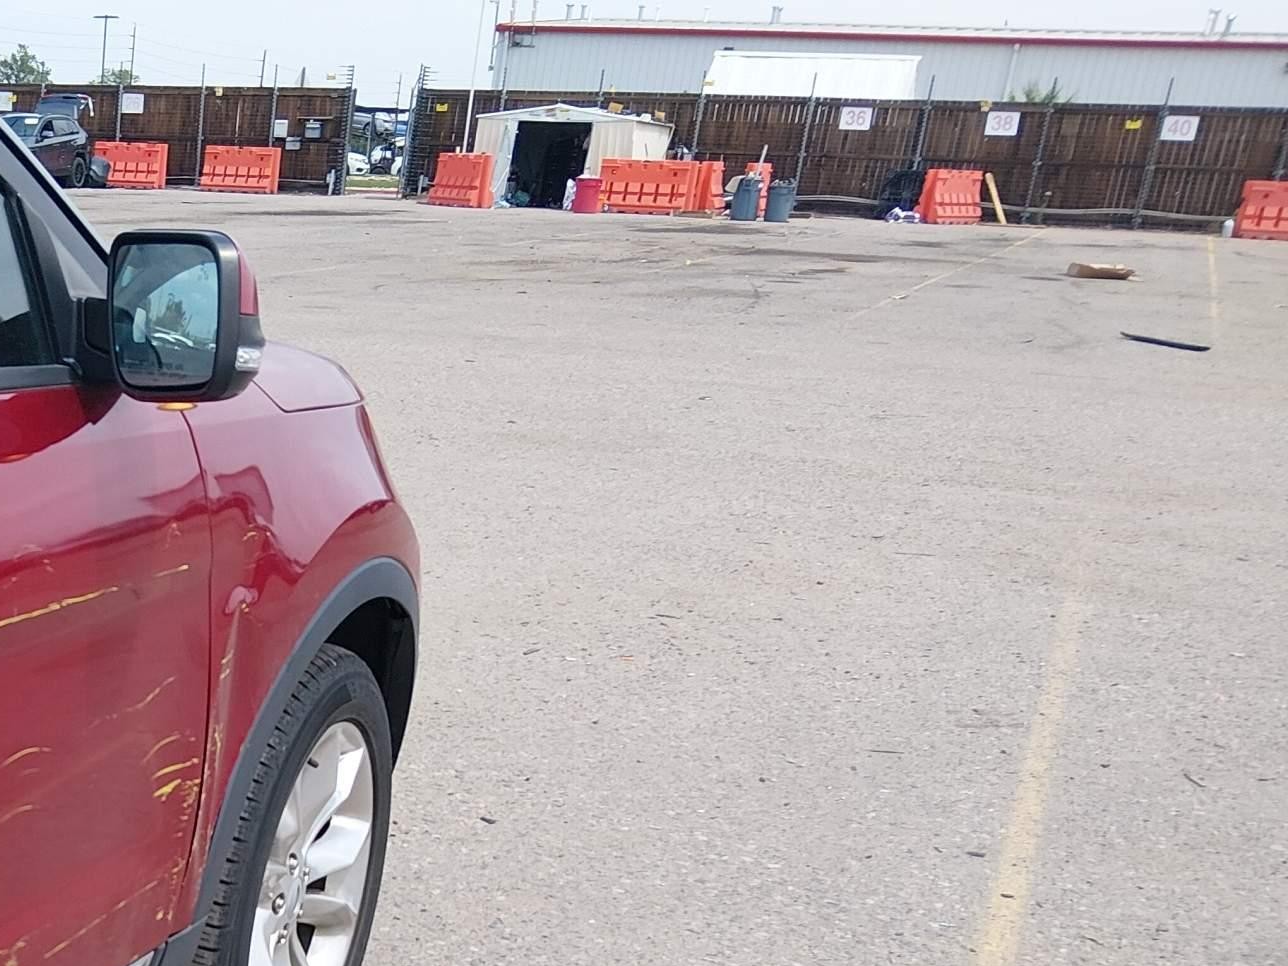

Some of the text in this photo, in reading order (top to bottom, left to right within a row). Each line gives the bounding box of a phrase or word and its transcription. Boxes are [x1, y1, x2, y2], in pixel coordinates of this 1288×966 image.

[845, 110, 867, 126] 36
[991, 114, 1013, 132] 38
[1167, 118, 1193, 137] 40
